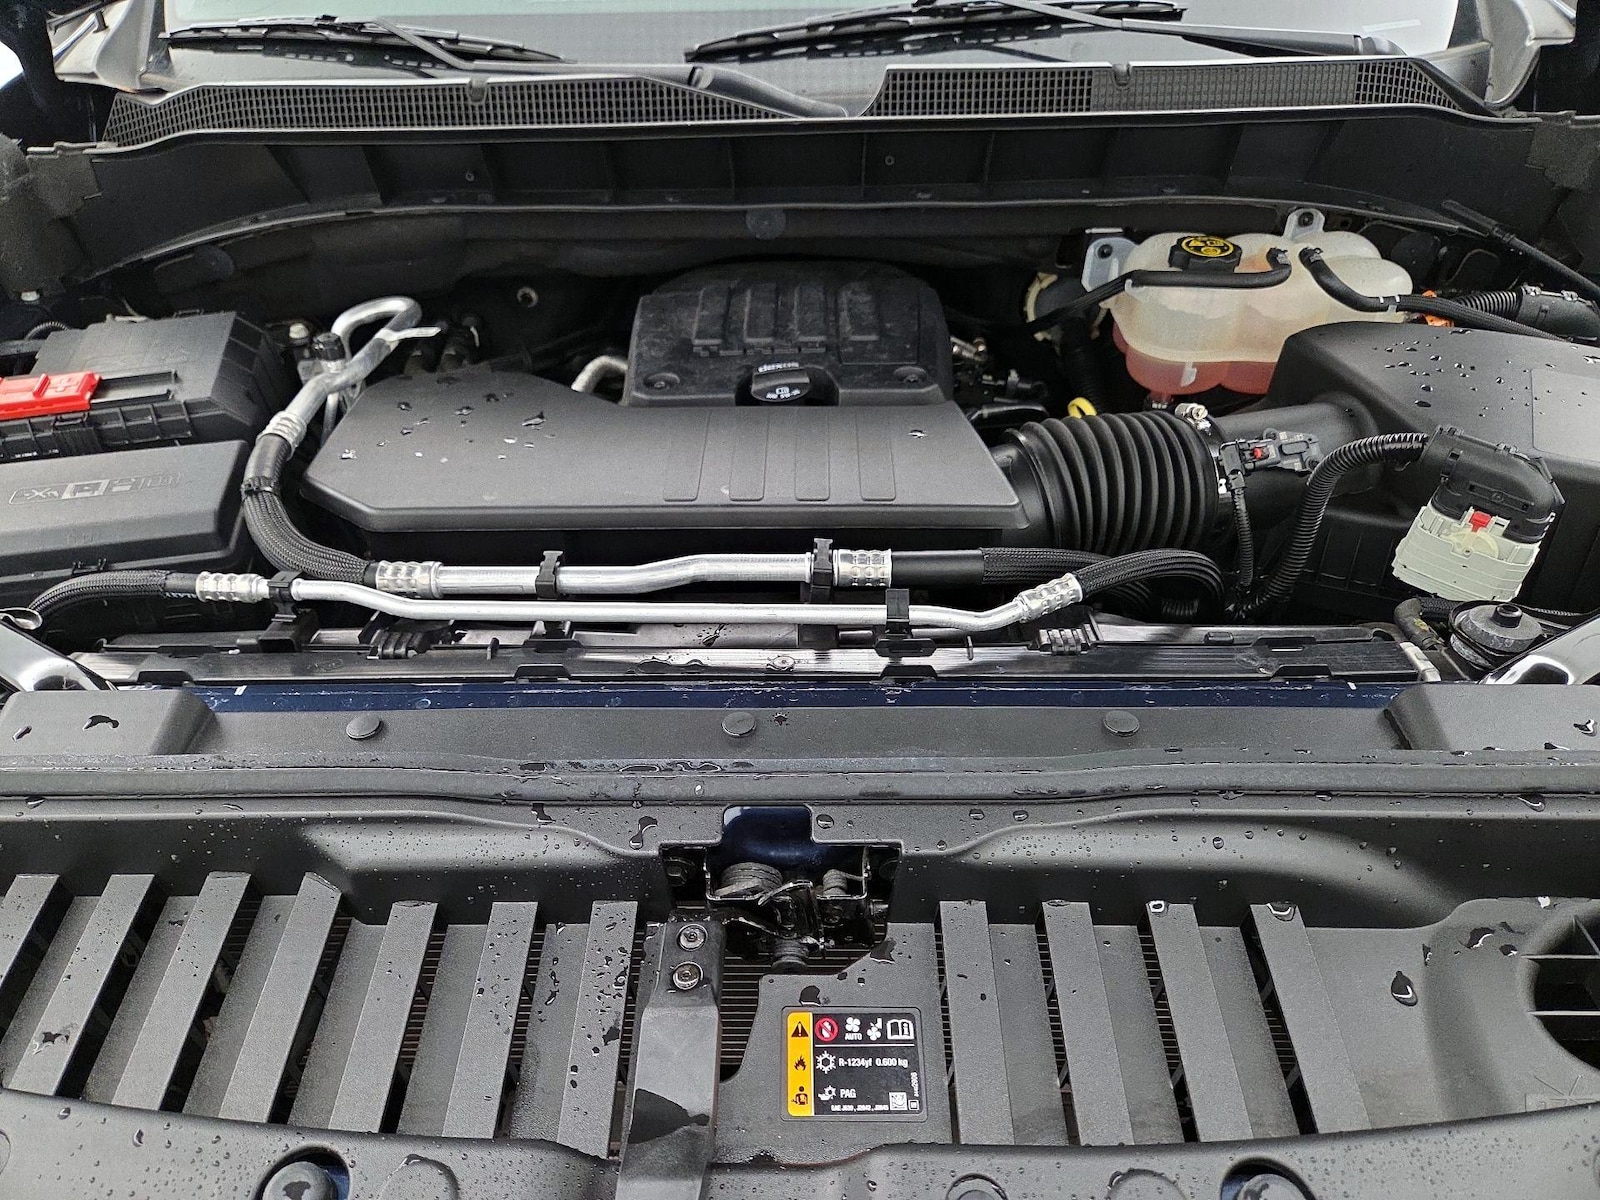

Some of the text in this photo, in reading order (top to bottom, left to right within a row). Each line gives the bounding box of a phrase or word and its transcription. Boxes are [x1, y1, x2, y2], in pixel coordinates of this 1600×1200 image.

[838, 1058, 908, 1068] R-1234yf 0.600 kg
[840, 1089, 856, 1098] PAG
